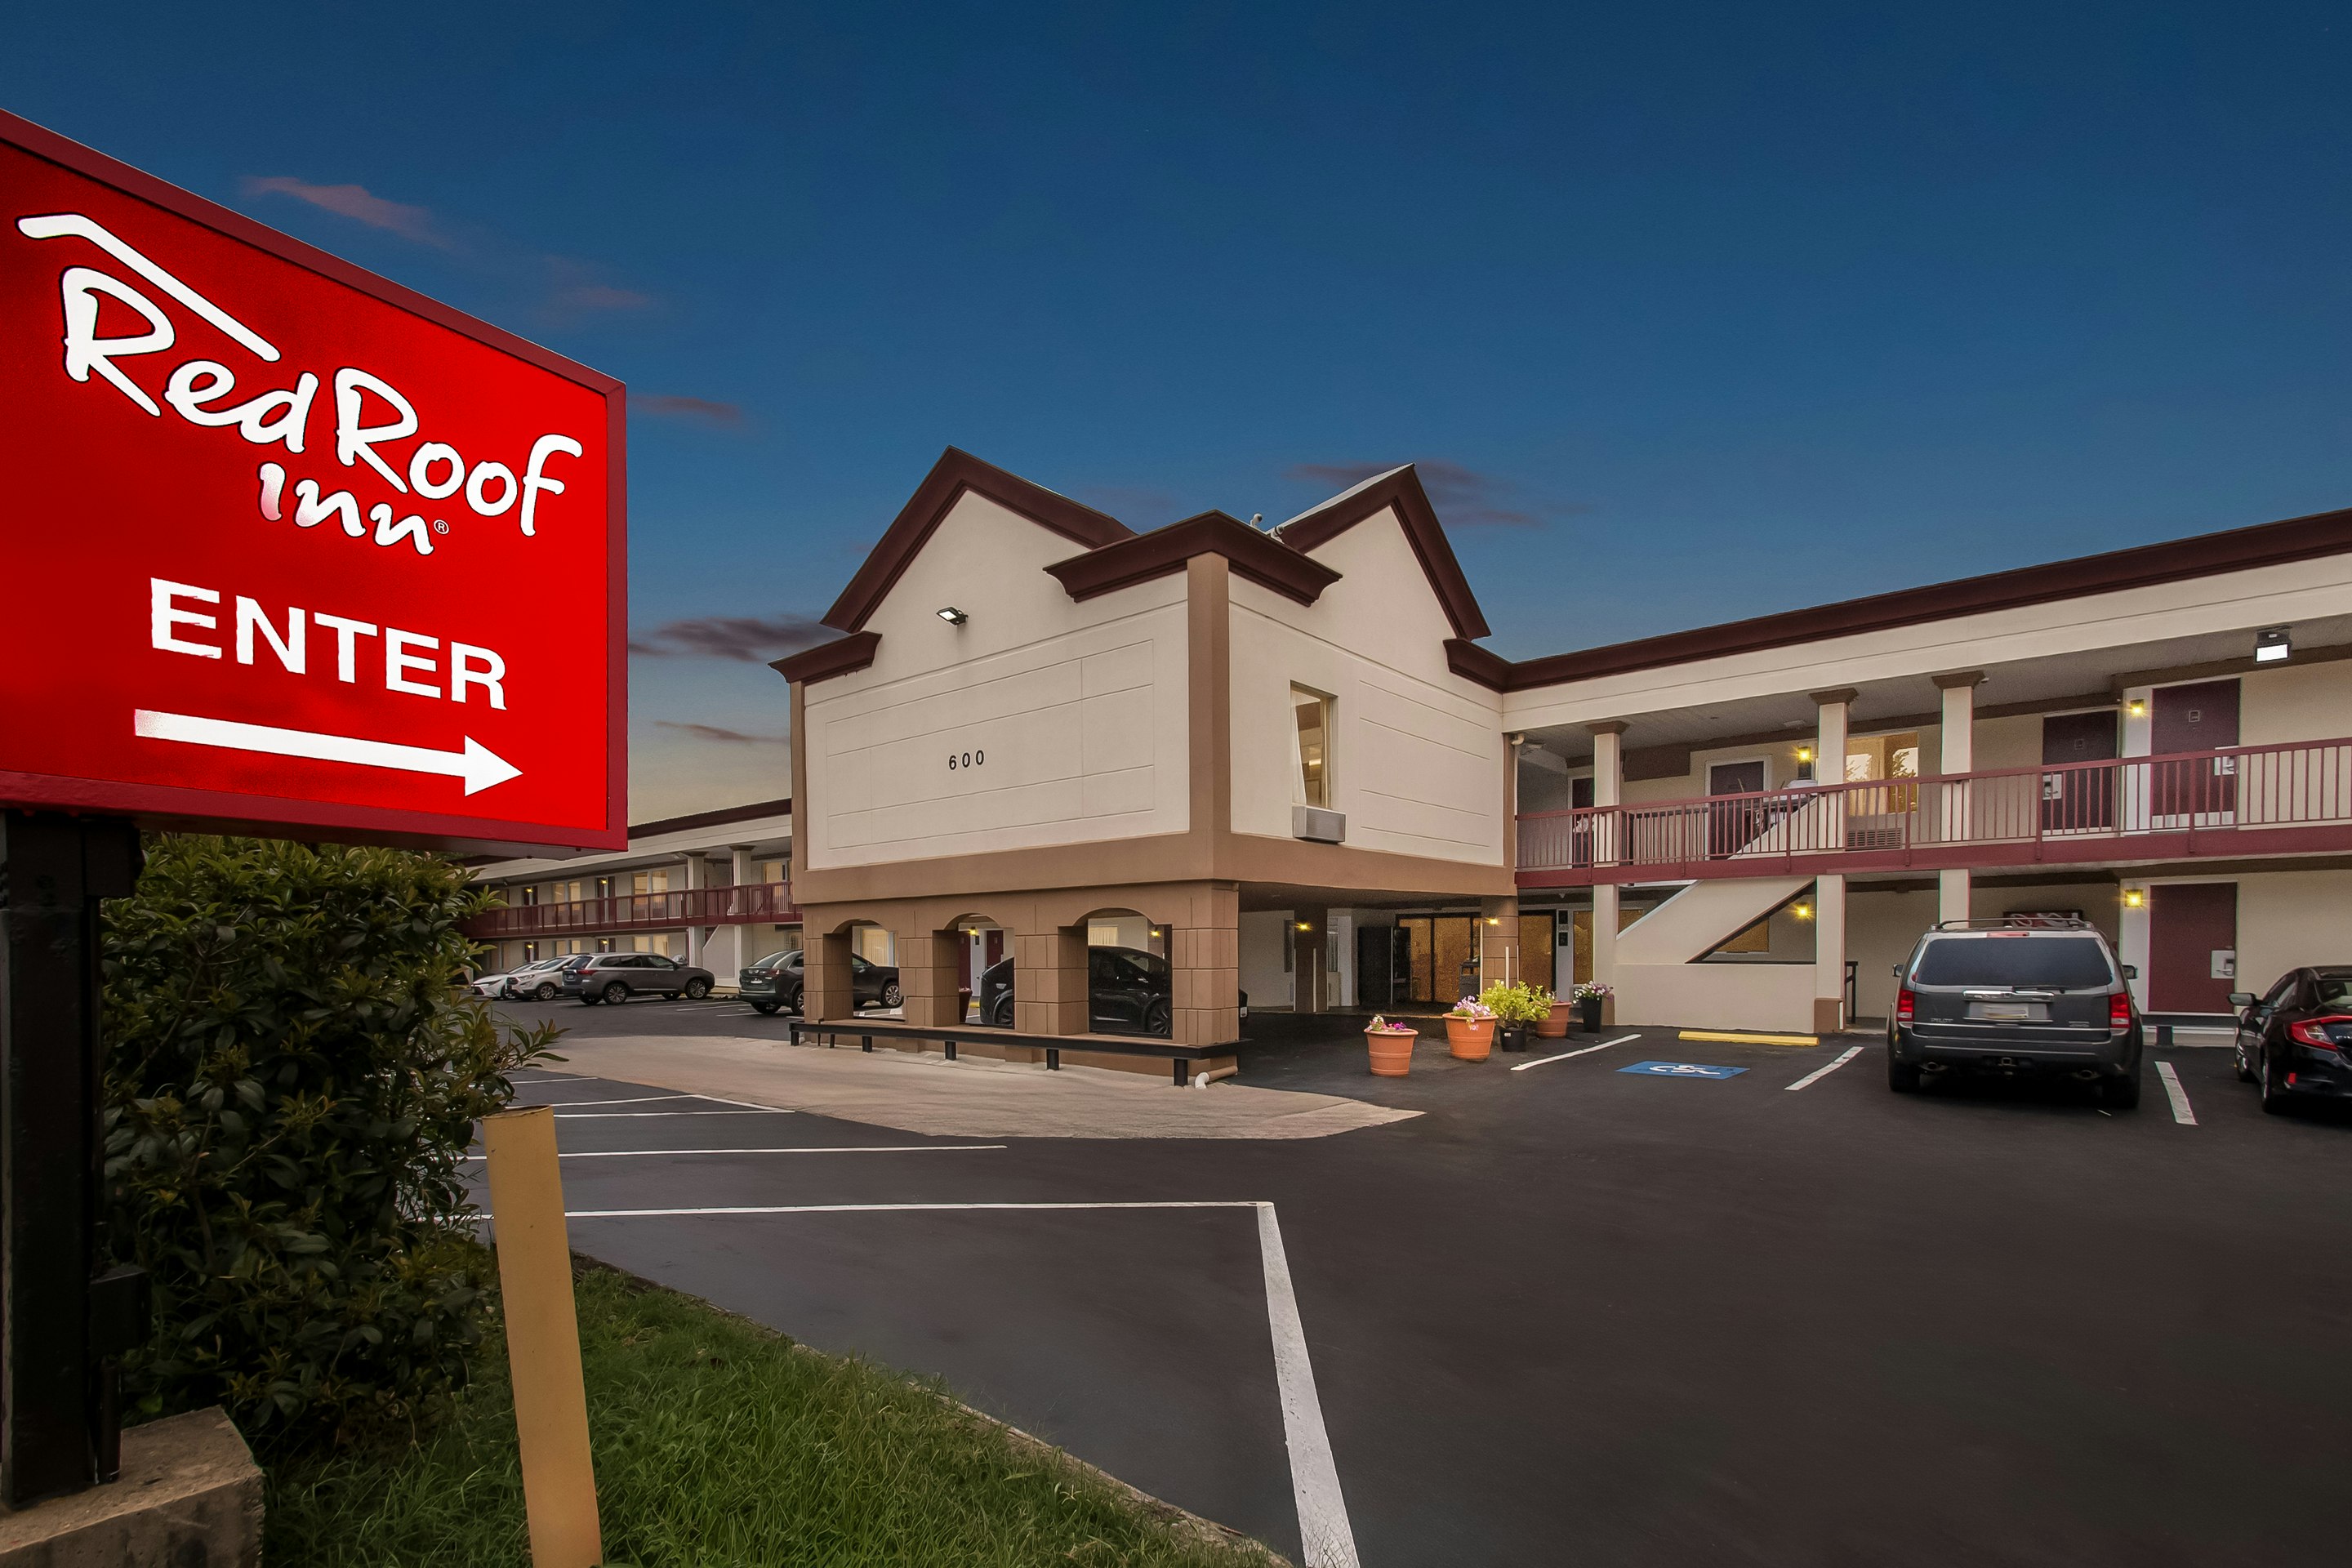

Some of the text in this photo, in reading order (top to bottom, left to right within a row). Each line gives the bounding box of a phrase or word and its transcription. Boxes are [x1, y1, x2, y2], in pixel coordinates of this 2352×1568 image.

[61, 266, 583, 537] Red Roof
[150, 577, 507, 710] ENTER
[948, 750, 985, 770] 600
